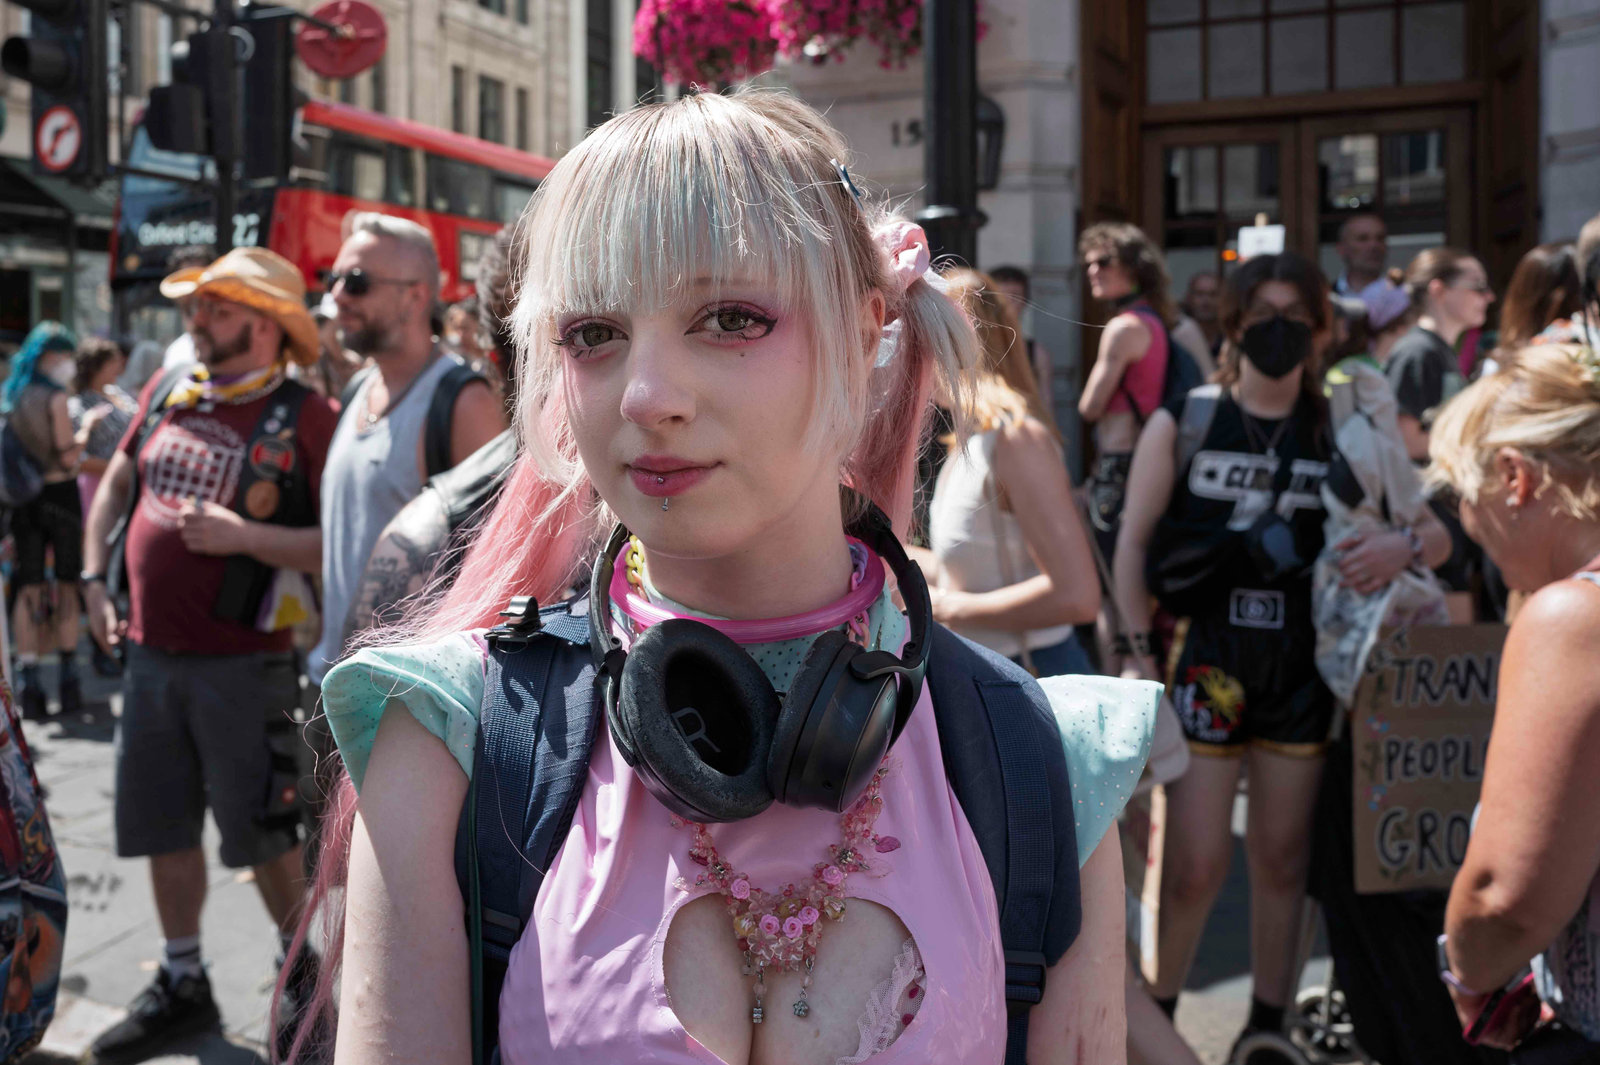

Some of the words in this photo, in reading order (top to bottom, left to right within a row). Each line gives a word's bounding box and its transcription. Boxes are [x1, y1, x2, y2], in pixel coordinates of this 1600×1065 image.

[138, 222, 187, 246] Oxford
[188, 221, 218, 245] Circ
[1390, 653, 1497, 706] TRAN
[671, 707, 721, 760] R
[1385, 735, 1489, 784] PEOPL
[1376, 808, 1470, 874] GRO
